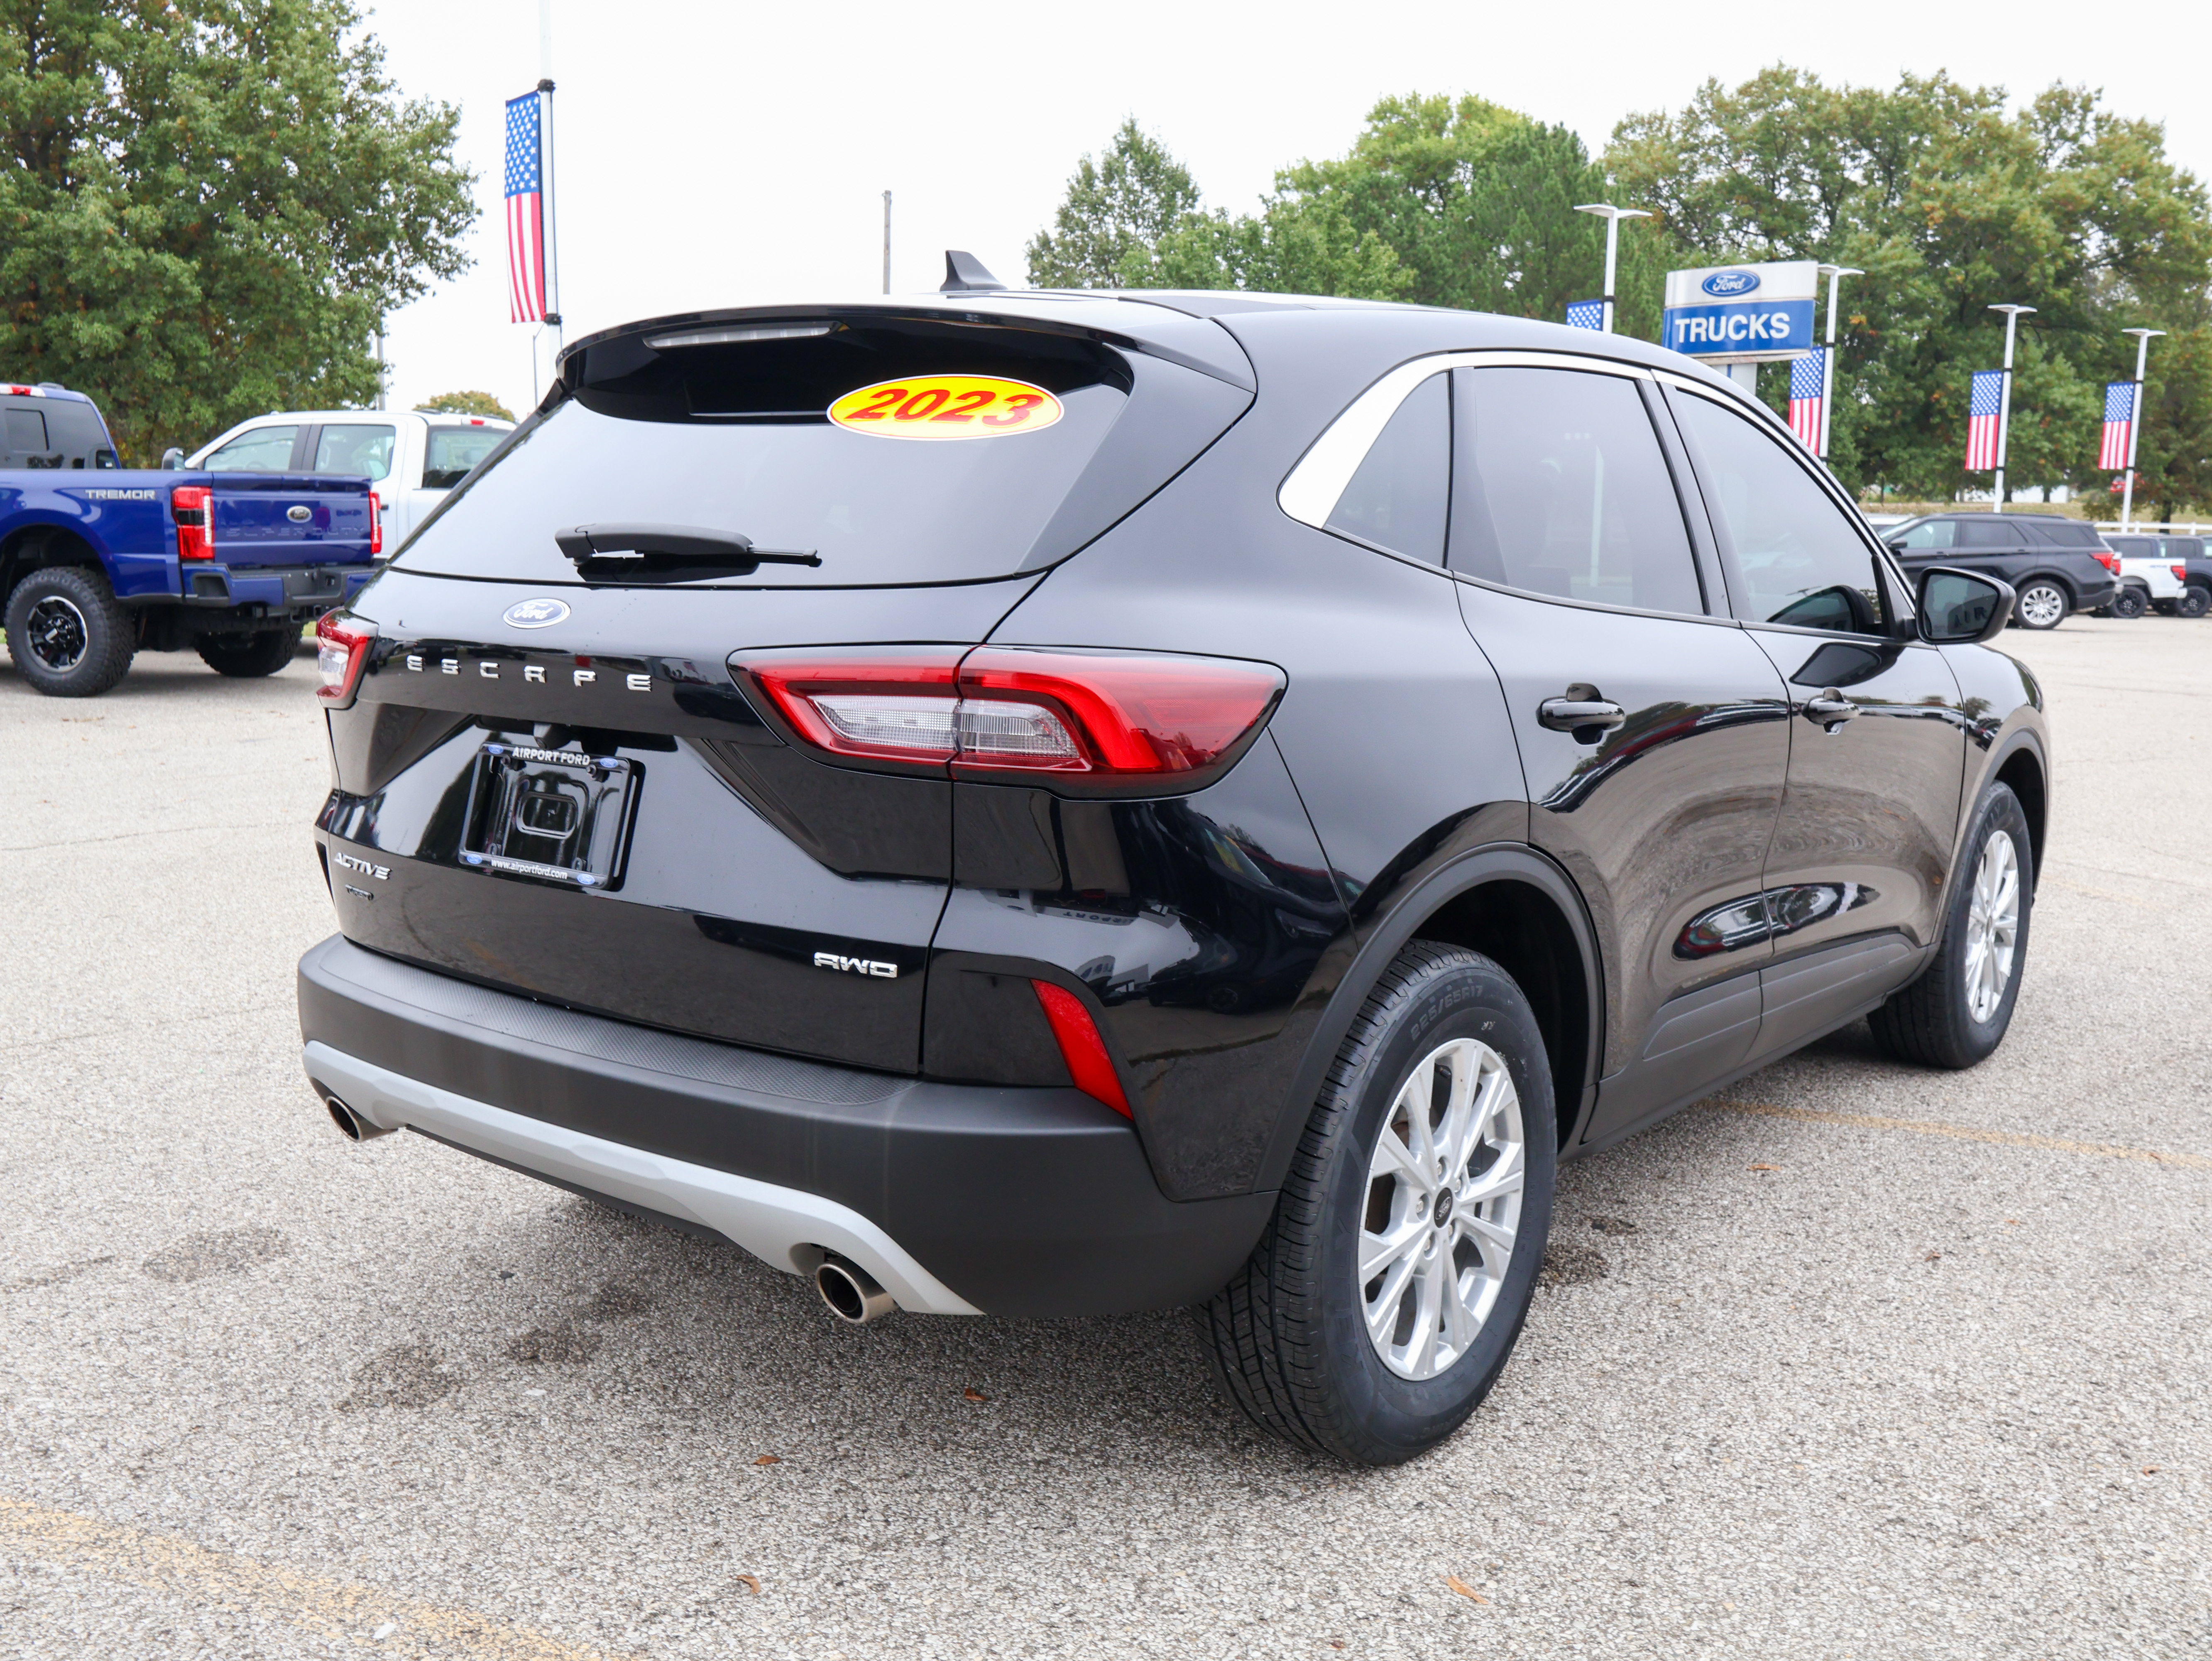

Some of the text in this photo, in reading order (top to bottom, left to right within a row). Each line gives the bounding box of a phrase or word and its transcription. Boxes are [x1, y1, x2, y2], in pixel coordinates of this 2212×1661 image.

[1712, 274, 1746, 291] Ford
[1675, 312, 1790, 343] TRUCKS
[844, 389, 1044, 427] 2023
[85, 489, 156, 500] TREMOR
[513, 602, 554, 620] Ford
[406, 655, 652, 692] ESCAPE
[512, 747, 560, 762] AIRPORT
[560, 752, 591, 765] FORD
[333, 852, 391, 880] ACTIVE
[491, 859, 568, 880] www.airportford.com
[814, 952, 898, 978] AWD
